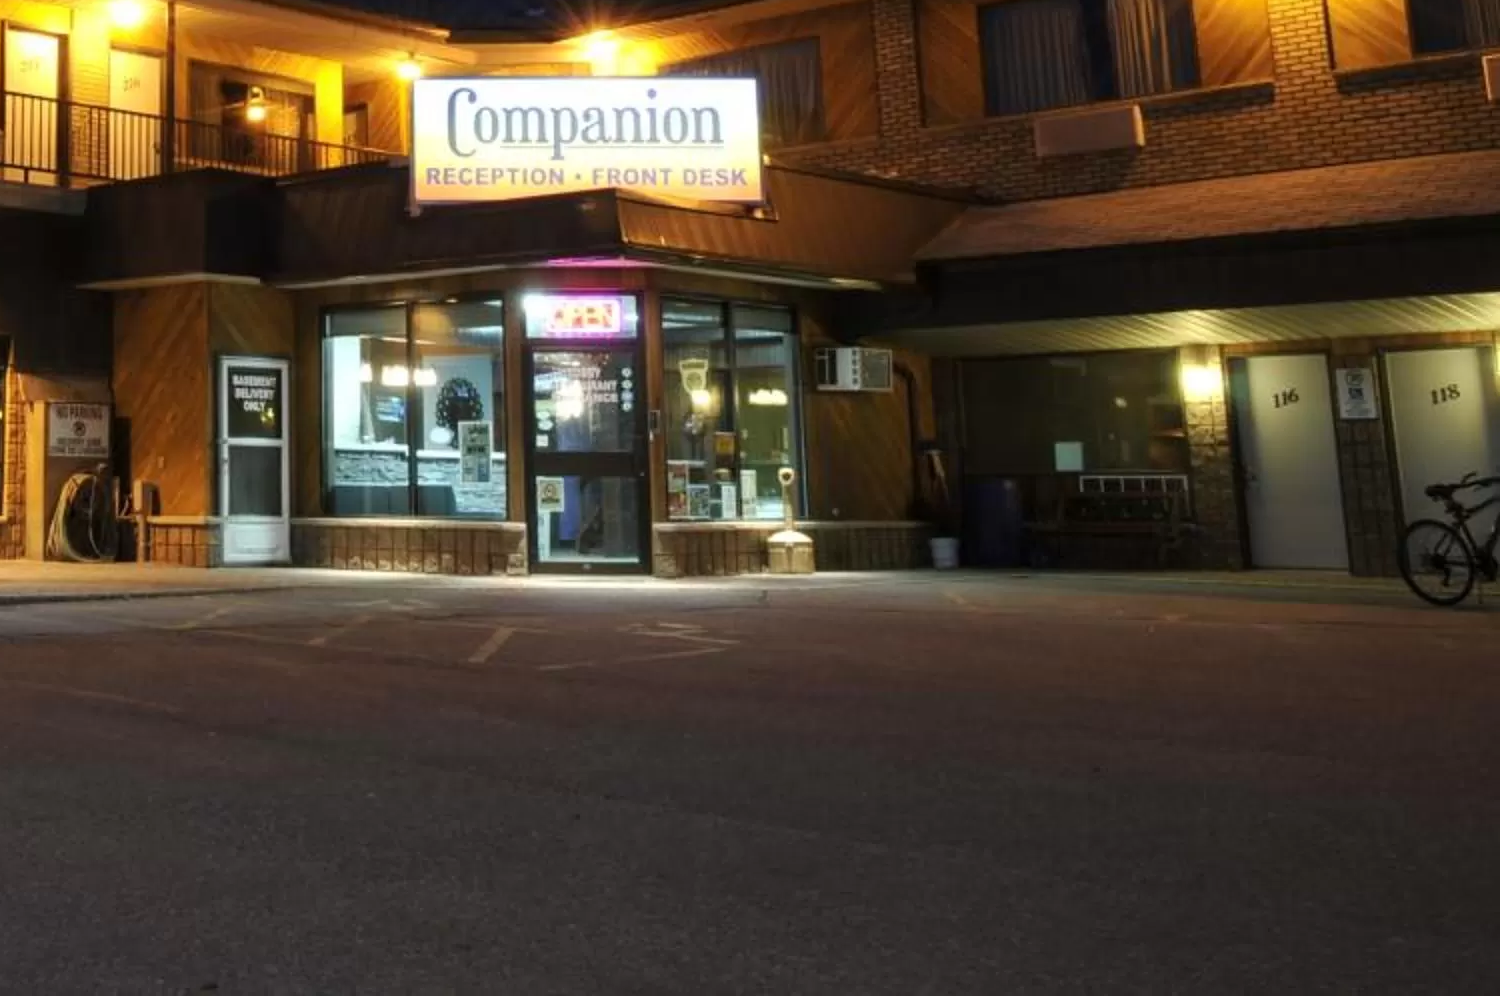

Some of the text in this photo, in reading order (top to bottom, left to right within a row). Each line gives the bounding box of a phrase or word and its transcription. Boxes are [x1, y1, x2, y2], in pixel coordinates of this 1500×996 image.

[447, 87, 724, 161] Companion
[426, 167, 748, 186] RECEPTION FRONT DESK
[552, 302, 617, 330] OPEN
[232, 375, 276, 387] BASEMENT
[234, 388, 275, 400] DELIVERY
[1272, 387, 1300, 408] 116
[1430, 383, 1461, 405] 118
[243, 400, 265, 412] ONLY
